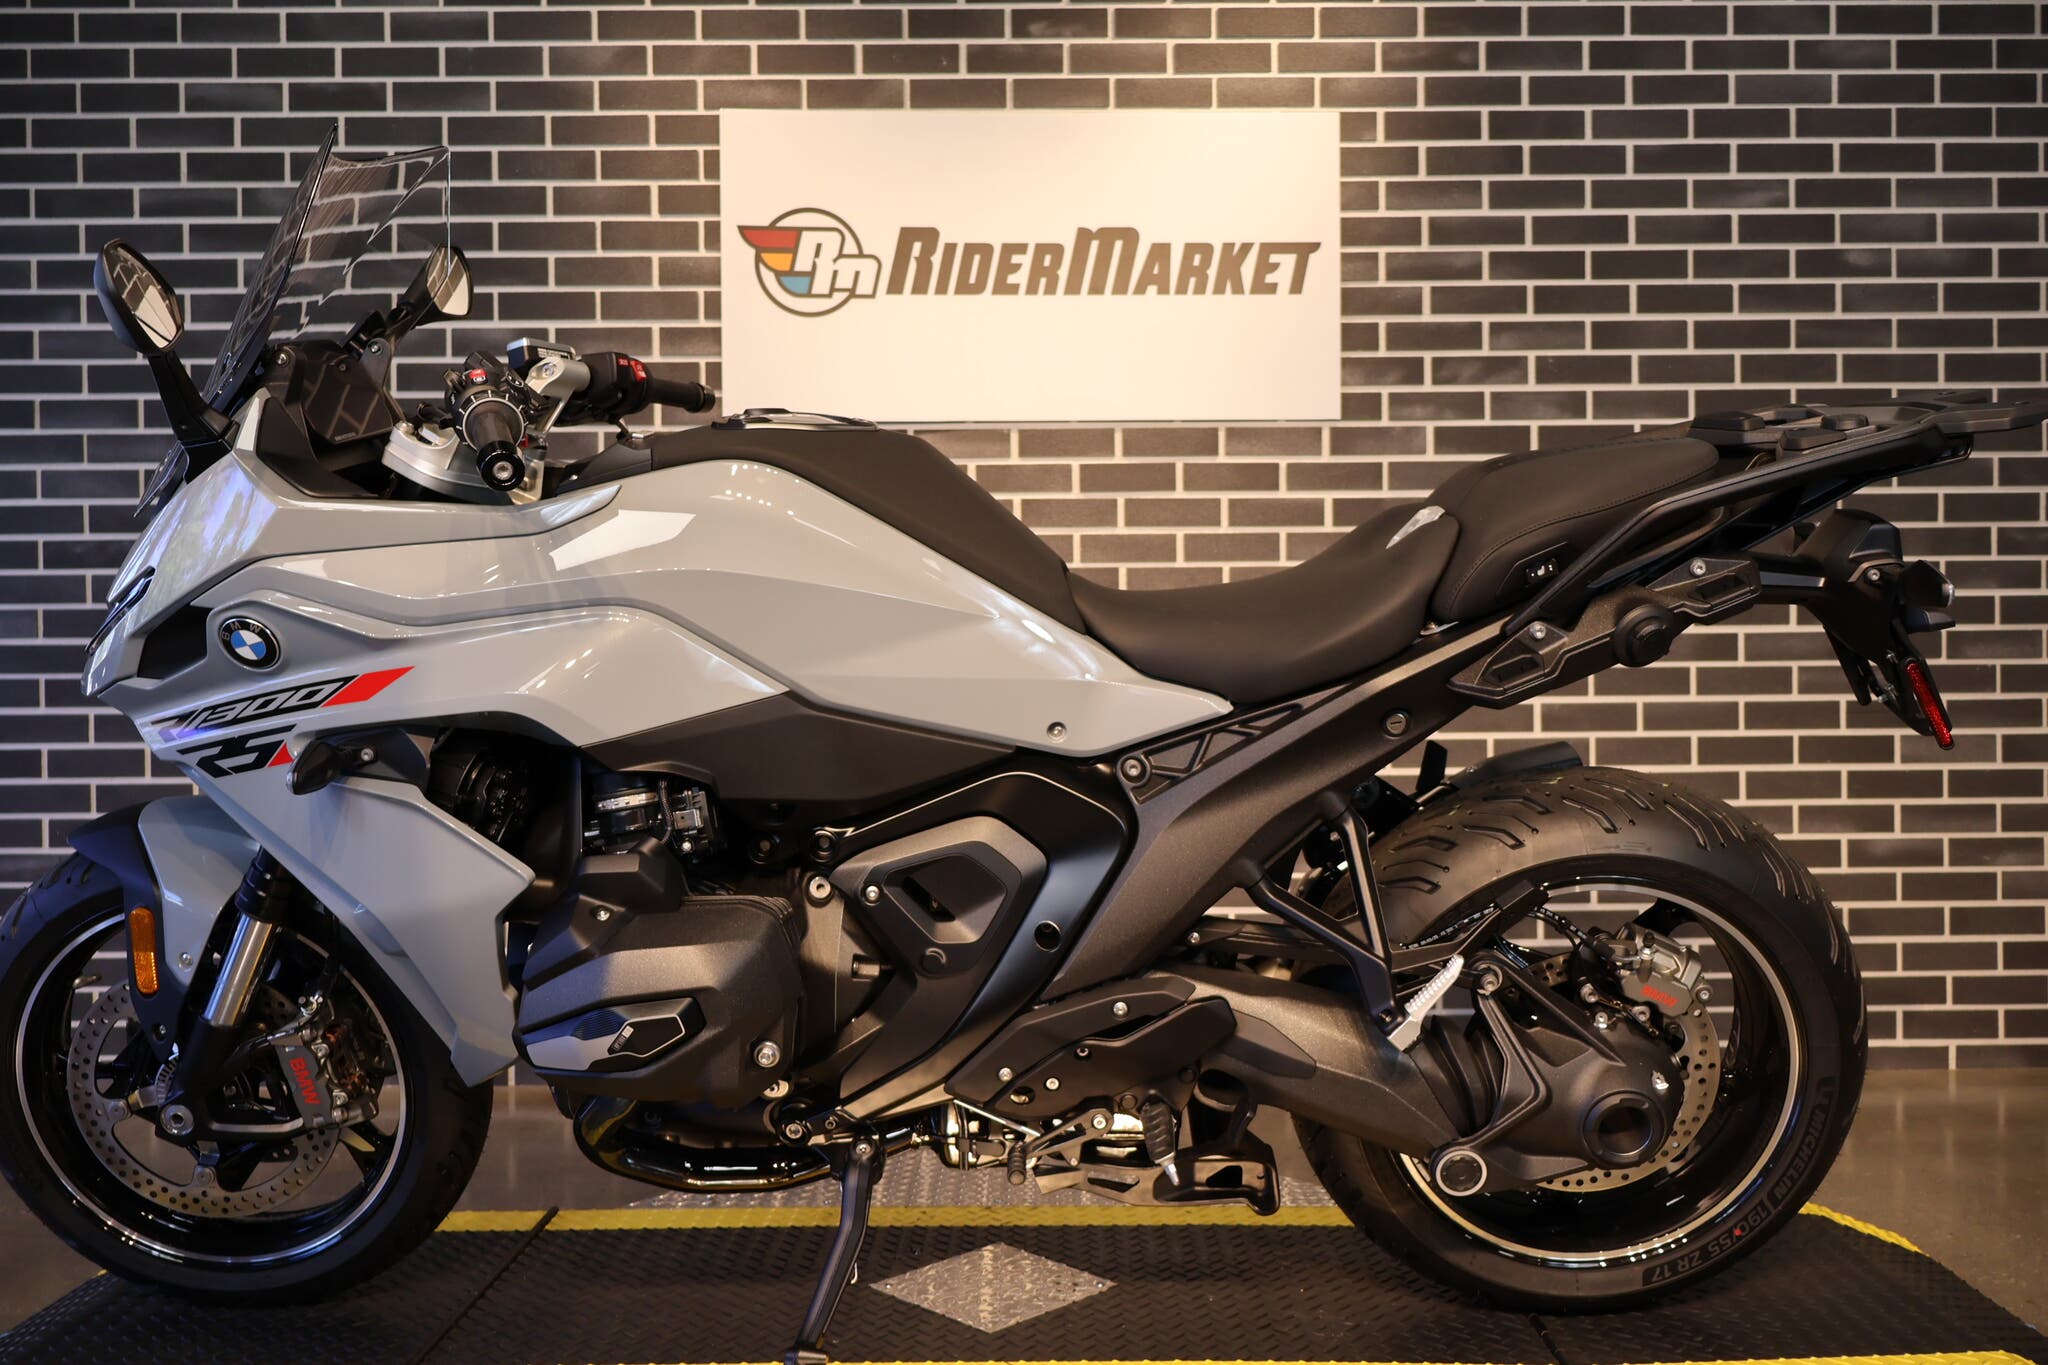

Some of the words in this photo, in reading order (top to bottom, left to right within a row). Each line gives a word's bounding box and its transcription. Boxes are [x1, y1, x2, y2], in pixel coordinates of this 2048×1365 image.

[221, 621, 261, 641] BMW
[1641, 984, 1678, 1007] BMW
[289, 1057, 321, 1105] BMW
[1773, 1108, 1827, 1200] MICHELIN
[1707, 1205, 1768, 1257] 190/55
[1651, 1263, 1672, 1281] 17
[1677, 1251, 1702, 1272] ZR
